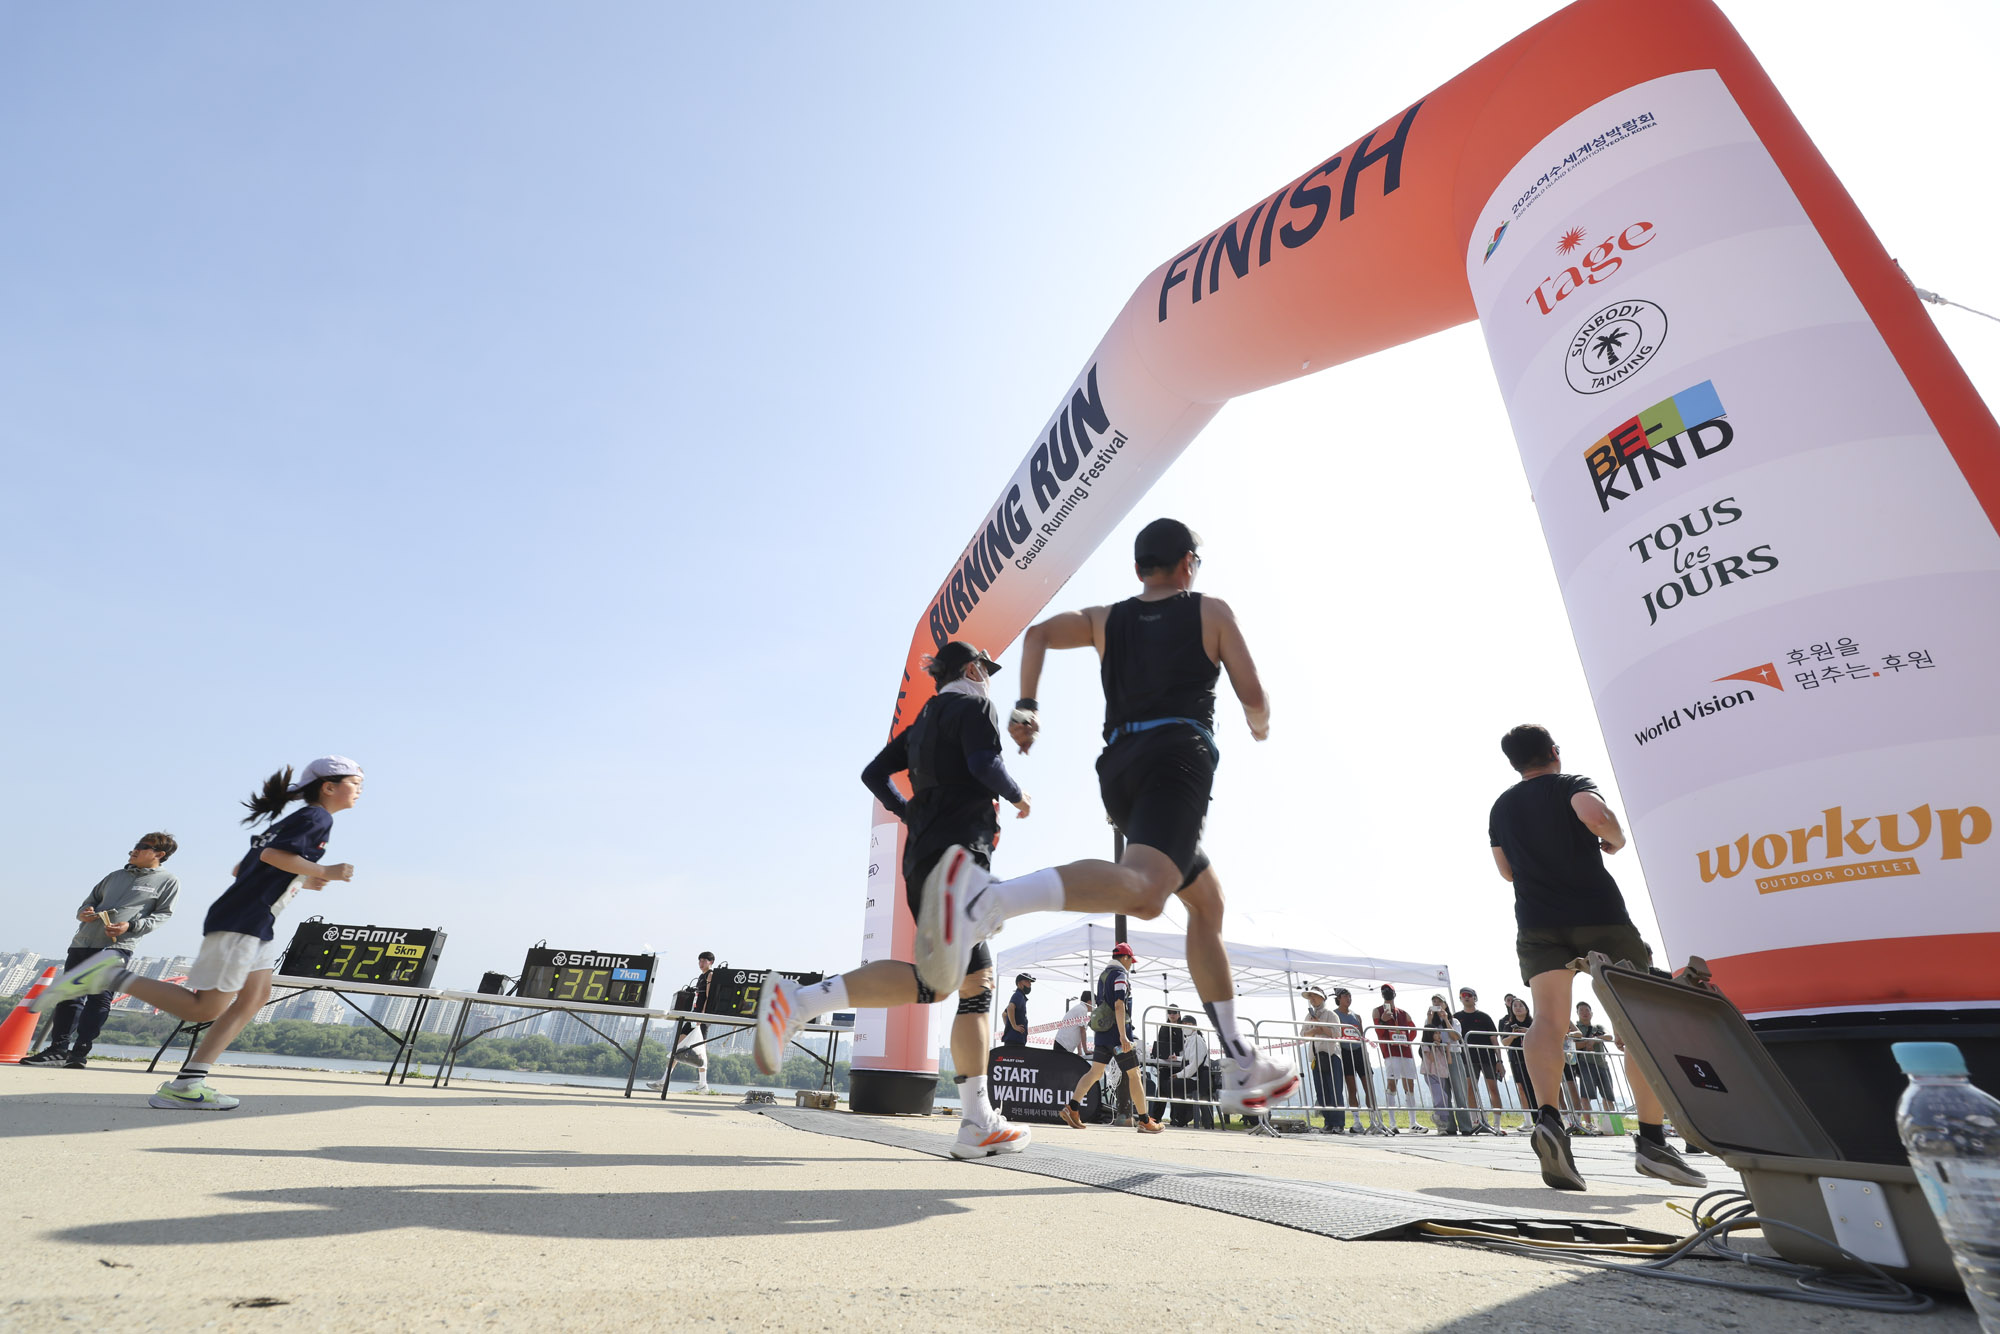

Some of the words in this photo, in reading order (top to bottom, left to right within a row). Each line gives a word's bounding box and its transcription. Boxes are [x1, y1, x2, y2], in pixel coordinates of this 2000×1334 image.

[1526, 188, 1545, 208] WORLD
[1545, 171, 1567, 190] ISLAND
[1567, 146, 1605, 172] EXHIBITION
[1605, 133, 1630, 148] YEOSU
[1631, 121, 1658, 134] KOREA
[1158, 98, 1427, 323] FINISH
[1572, 304, 1645, 357] SUNBODY
[1590, 345, 1653, 389] TANNING
[1594, 418, 1734, 513] KIND
[929, 483, 1033, 650] BURNING
[1030, 361, 1111, 514] RUN
[1015, 531, 1048, 570] Casual
[1041, 485, 1089, 537] Running
[1078, 429, 1129, 488] Festival
[1628, 496, 1743, 564] TOUS
[1673, 545, 1711, 574] les
[1641, 544, 1779, 627] JOURS
[1786, 636, 1860, 667] 후원을
[1634, 710, 1682, 746] World
[1682, 689, 1755, 721] Vision
[1760, 870, 1835, 891] OUTDOOR
[1843, 861, 1913, 878] OUTLET
[340, 928, 408, 944] SAMIK
[394, 945, 417, 956] 5km
[568, 953, 630, 969] SAMIK
[619, 969, 640, 980] 7km
[993, 1065, 1039, 1084] START
[1693, 1063, 1706, 1078] 3
[993, 1085, 1053, 1105] WAITING
